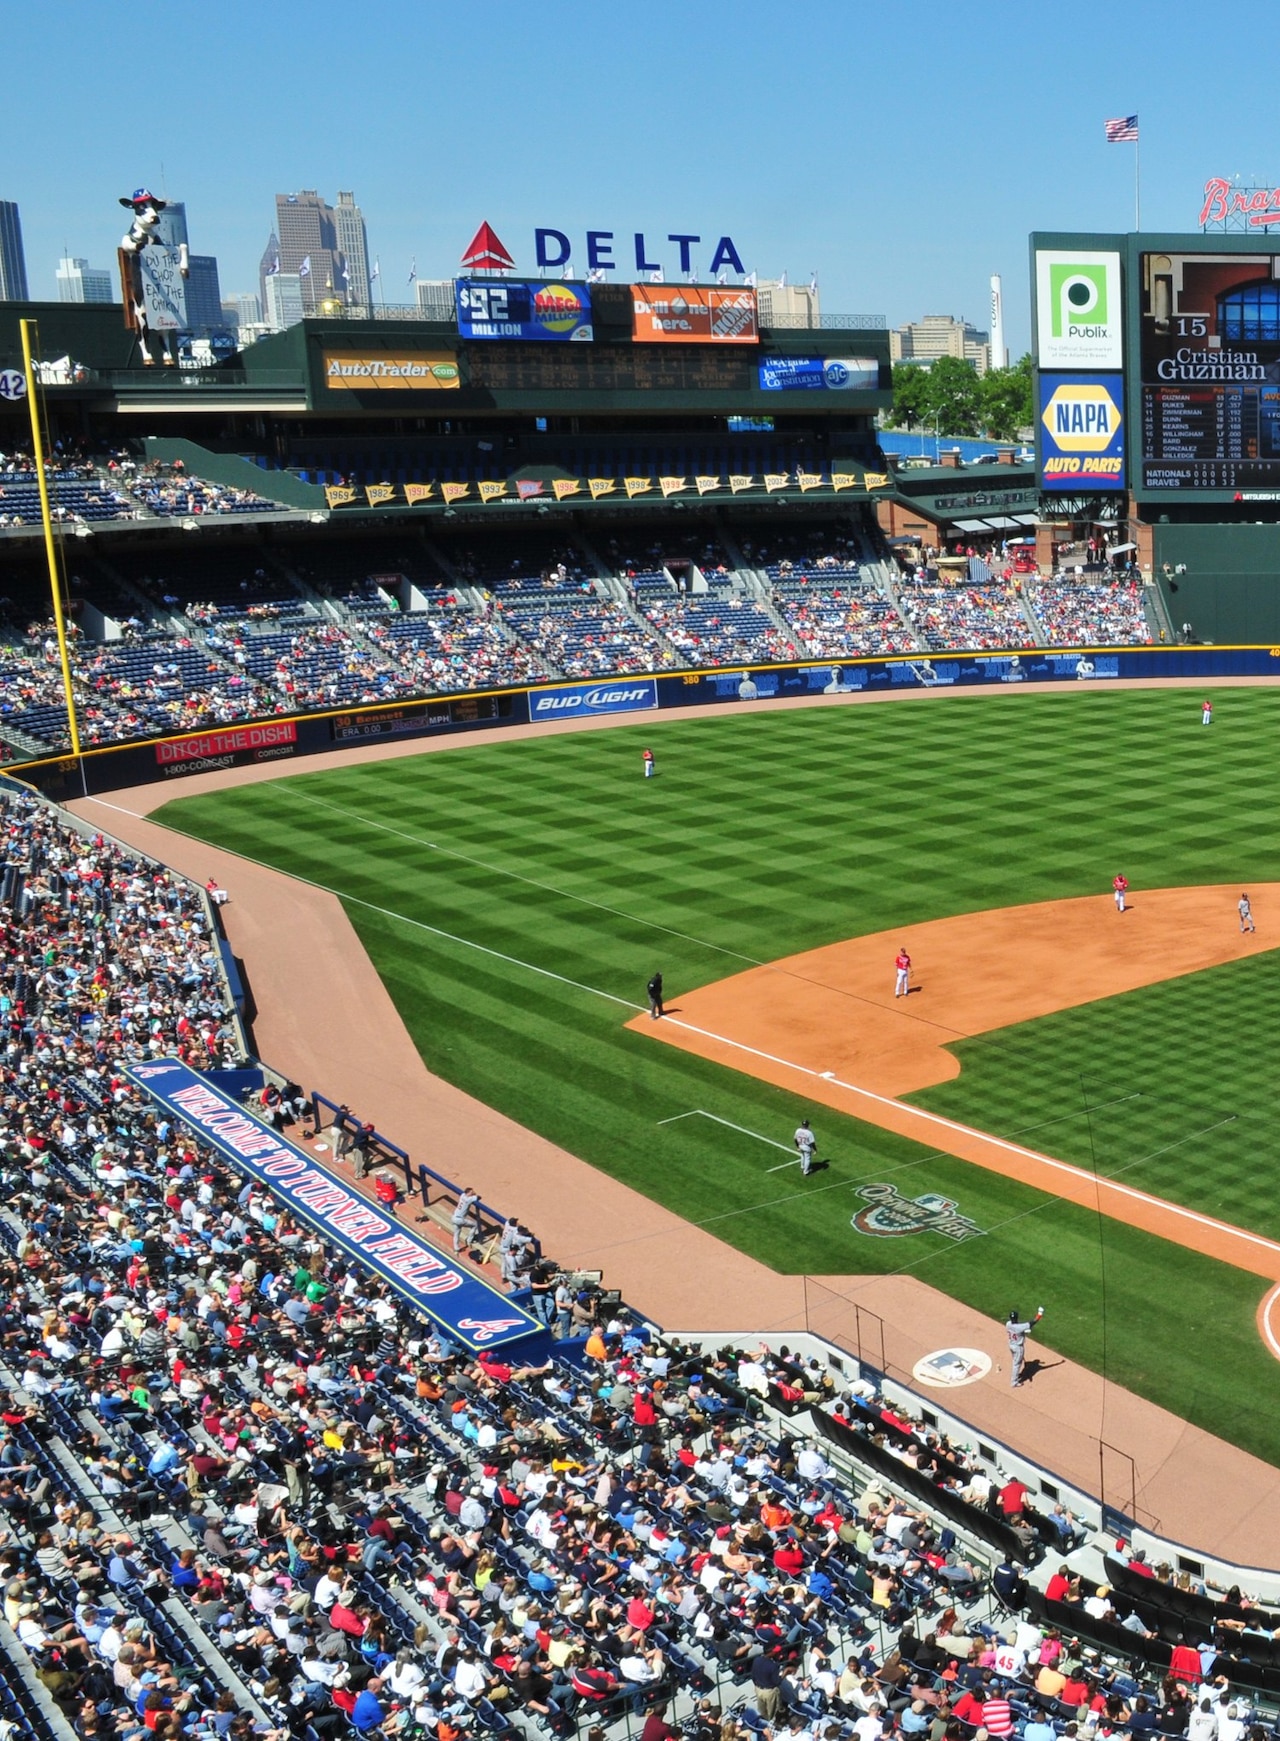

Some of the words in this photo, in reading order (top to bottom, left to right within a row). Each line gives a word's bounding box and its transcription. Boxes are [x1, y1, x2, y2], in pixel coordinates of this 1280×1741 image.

[535, 228, 745, 274] DELTA
[162, 253, 180, 268] THE
[151, 269, 174, 282] CHOP
[146, 284, 161, 297] EAT
[165, 284, 184, 299] THE
[534, 292, 581, 313] MEGA
[634, 300, 669, 314] Drill
[716, 297, 734, 316] THE
[712, 292, 753, 338] HOME
[472, 323, 522, 336] MILLION
[652, 317, 692, 330] here.
[729, 310, 753, 338] DEPOT
[1177, 318, 1207, 337] 15
[1069, 326, 1108, 338] Publix
[1176, 348, 1258, 365] Cristian
[327, 361, 430, 377] AutoTrader
[1157, 359, 1267, 381] Guzman
[0, 375, 24, 397] 42
[1056, 404, 1109, 433] NAPA
[1043, 457, 1081, 473] AUTO
[1082, 457, 1123, 473] PARTS
[1146, 470, 1191, 478] NATIONALS
[482, 485, 500, 493] 1993
[592, 482, 609, 490] 1997
[628, 481, 645, 489] 1998
[662, 481, 680, 489] 1999
[733, 479, 748, 487] 2001
[329, 491, 349, 501] 1969
[369, 489, 389, 498] 1982
[408, 487, 426, 497] 1991
[446, 486, 463, 495] 1992
[683, 675, 700, 685] 380
[535, 696, 582, 711] BUD
[588, 688, 650, 706] LIGHT
[336, 716, 351, 727] 30
[356, 711, 404, 724] Bennett
[429, 716, 449, 725] MPH
[342, 726, 360, 737] ERA
[364, 724, 381, 734] 0.00
[161, 739, 212, 761] DITCH
[213, 733, 247, 754] THE
[250, 724, 293, 746] DISH!
[257, 745, 294, 758] comcast
[58, 759, 78, 773] 335
[163, 754, 235, 776] 1-800-COMCAST
[168, 1083, 263, 1157] WELCOME
[251, 1148, 303, 1179] TO
[278, 1169, 392, 1243] TURNER
[363, 1232, 464, 1295] FIELD
[998, 1654, 1015, 1671] 45
